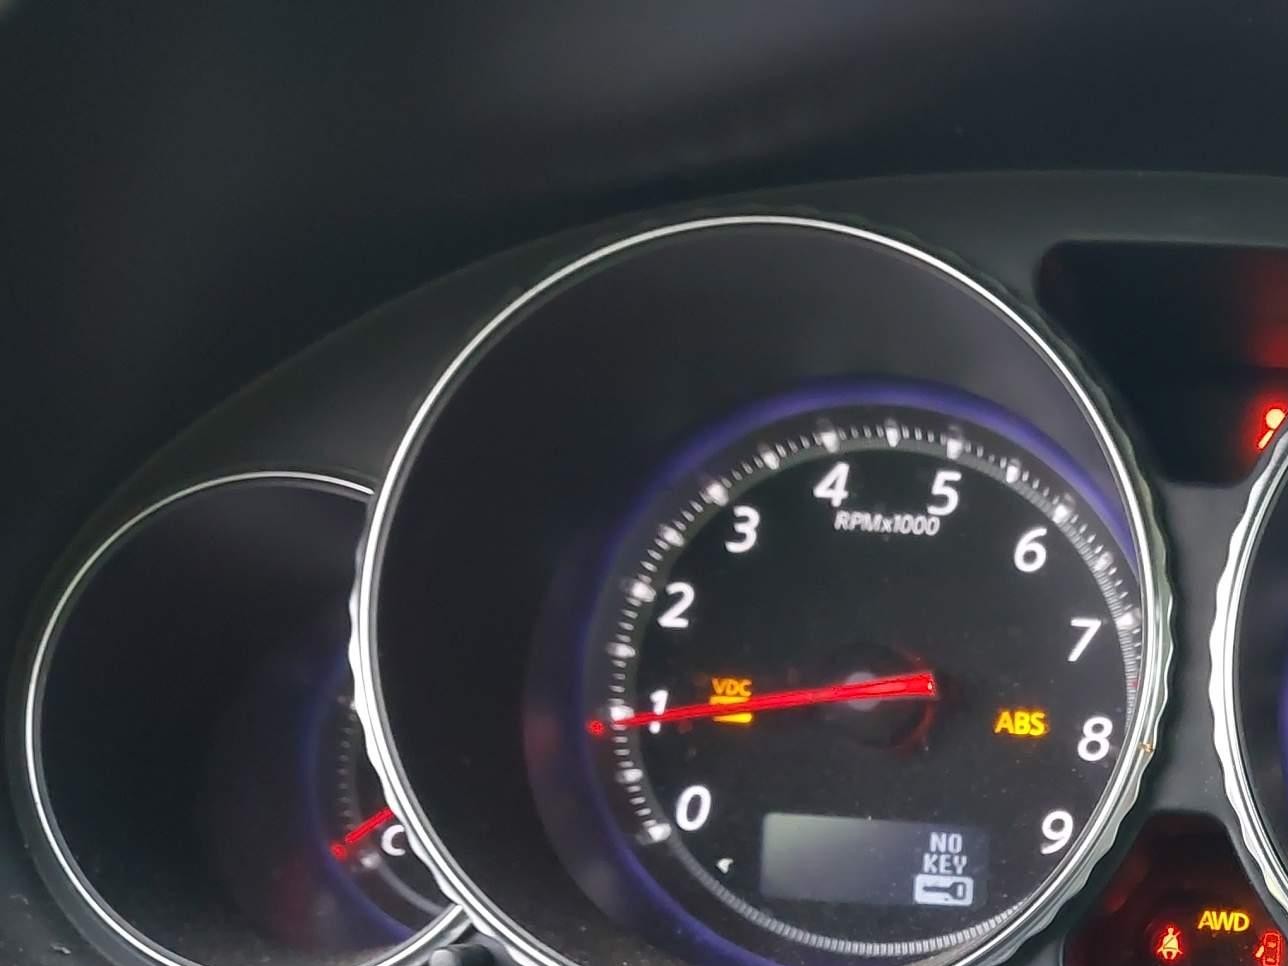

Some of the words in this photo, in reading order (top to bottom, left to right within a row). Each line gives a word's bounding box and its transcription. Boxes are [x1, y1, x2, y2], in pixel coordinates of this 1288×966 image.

[814, 462, 849, 507] 4
[928, 471, 961, 515] 5
[726, 506, 760, 552] 3
[1014, 526, 1047, 572] 6
[659, 582, 694, 628] 2
[1068, 617, 1102, 662] 7
[711, 678, 752, 697] VDC
[650, 690, 668, 734] 1
[994, 711, 1044, 735] ABS
[1077, 716, 1113, 761] 8
[676, 785, 711, 831] 0
[381, 825, 404, 856] C
[930, 832, 962, 853] NO
[1041, 810, 1073, 854] 9
[924, 853, 967, 874] KEY
[1198, 911, 1250, 932] AWD
